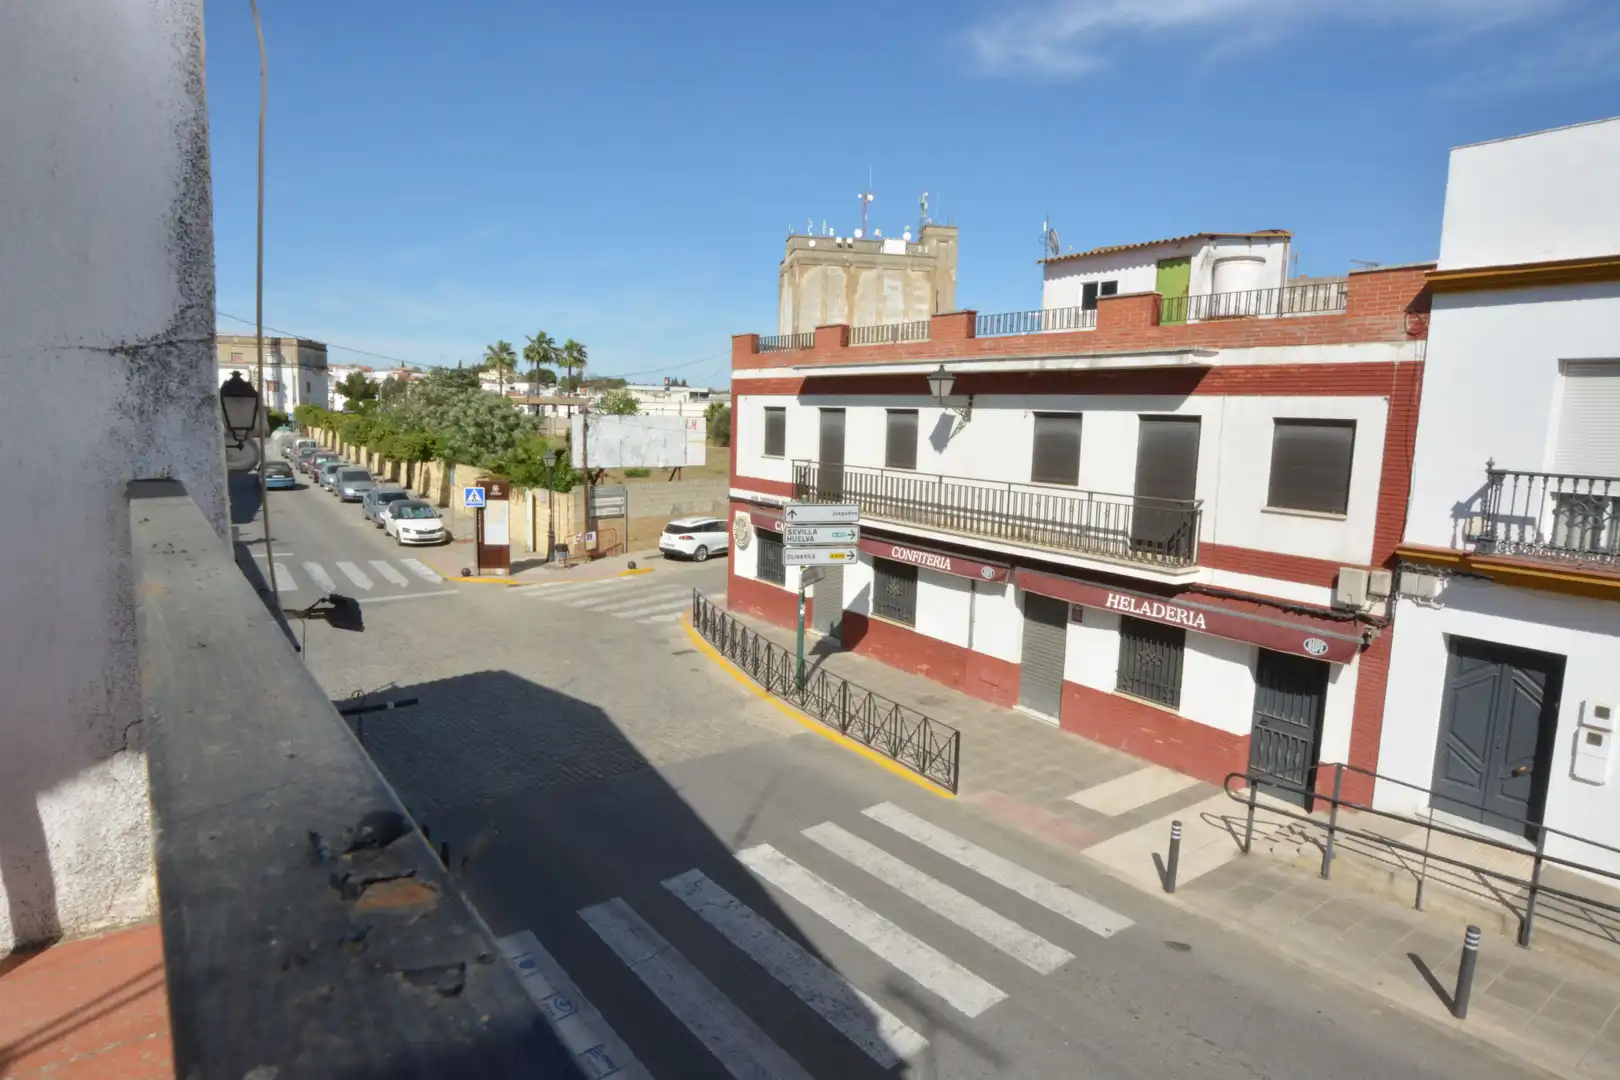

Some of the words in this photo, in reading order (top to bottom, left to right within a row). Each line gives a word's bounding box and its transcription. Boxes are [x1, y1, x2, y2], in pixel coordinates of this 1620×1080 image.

[786, 535, 815, 543] HUELVA
[787, 528, 818, 536] SEVILLA
[891, 546, 952, 570] CONFITERIA
[1105, 592, 1207, 629] HELADERIA
